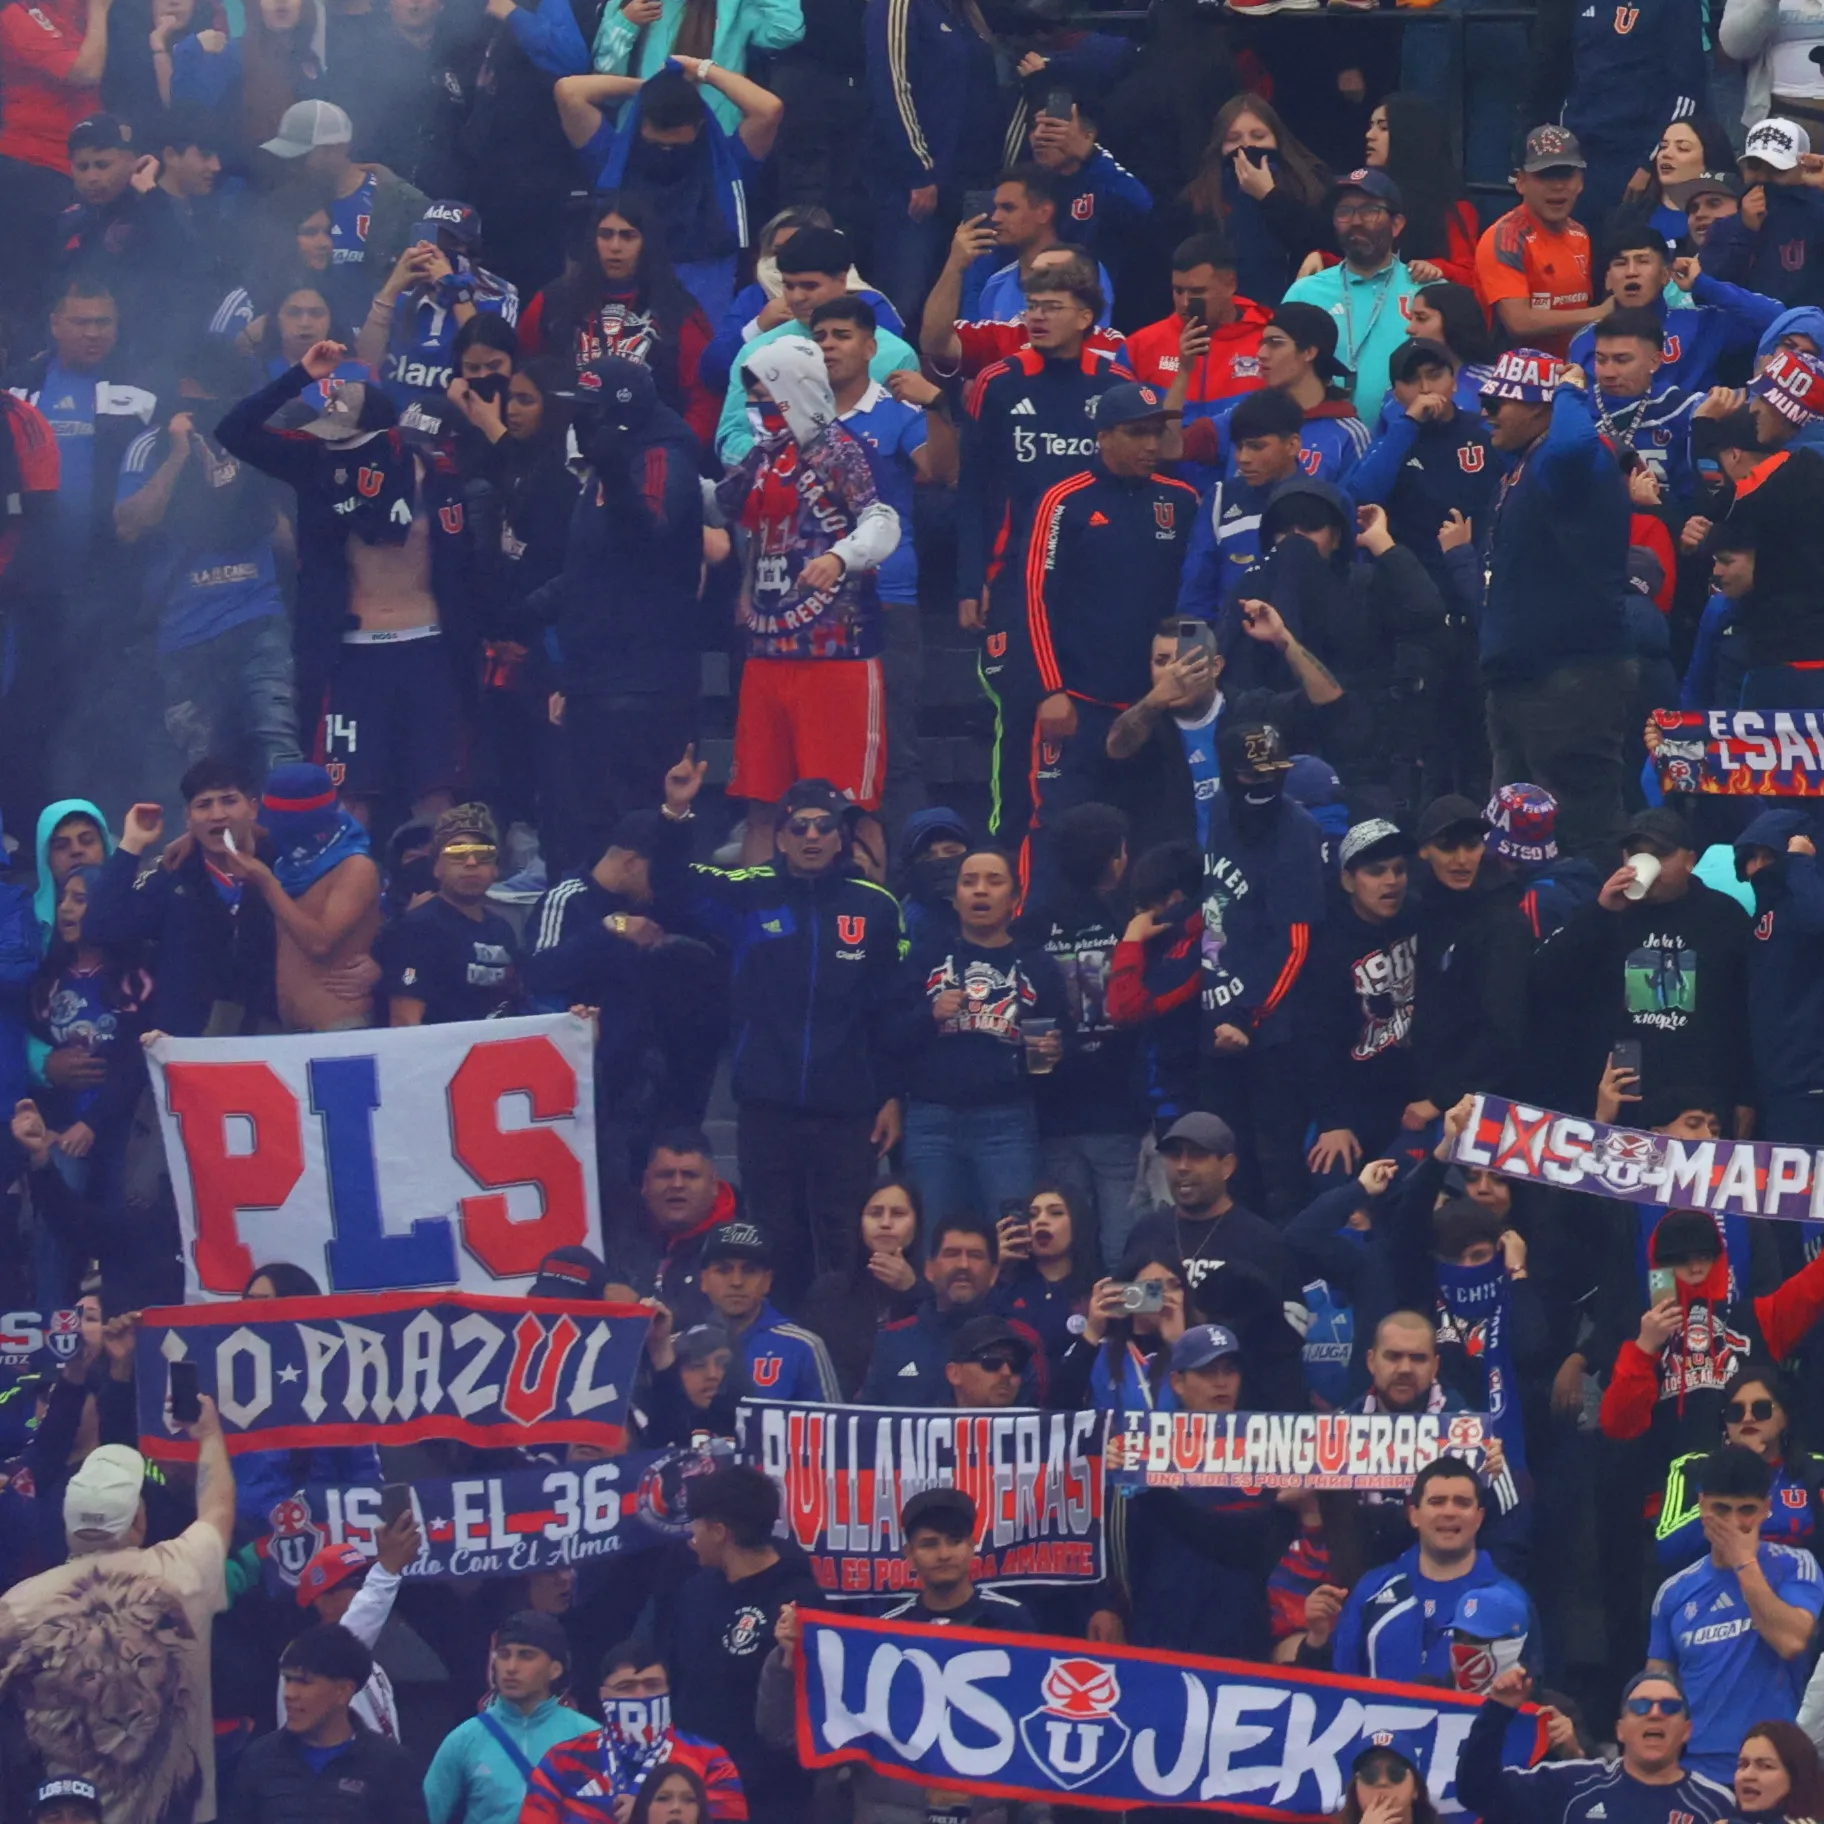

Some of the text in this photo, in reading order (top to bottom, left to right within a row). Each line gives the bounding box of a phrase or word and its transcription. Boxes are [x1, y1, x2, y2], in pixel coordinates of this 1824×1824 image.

[325, 713, 357, 754] 14
[164, 1033, 590, 1294] PLS
[298, 1308, 619, 1427] PRAZUL
[1148, 1415, 1440, 1477] BULLANGUERAS
[453, 1477, 515, 1553] EL
[542, 1464, 621, 1543] 36
[1354, 1474, 1416, 1489] AMART
[450, 1548, 501, 1576] Con
[507, 1544, 540, 1571] El
[546, 1533, 623, 1568] Alma
[1003, 1541, 1094, 1577] AMARTE
[816, 1629, 1016, 1777] LOS
